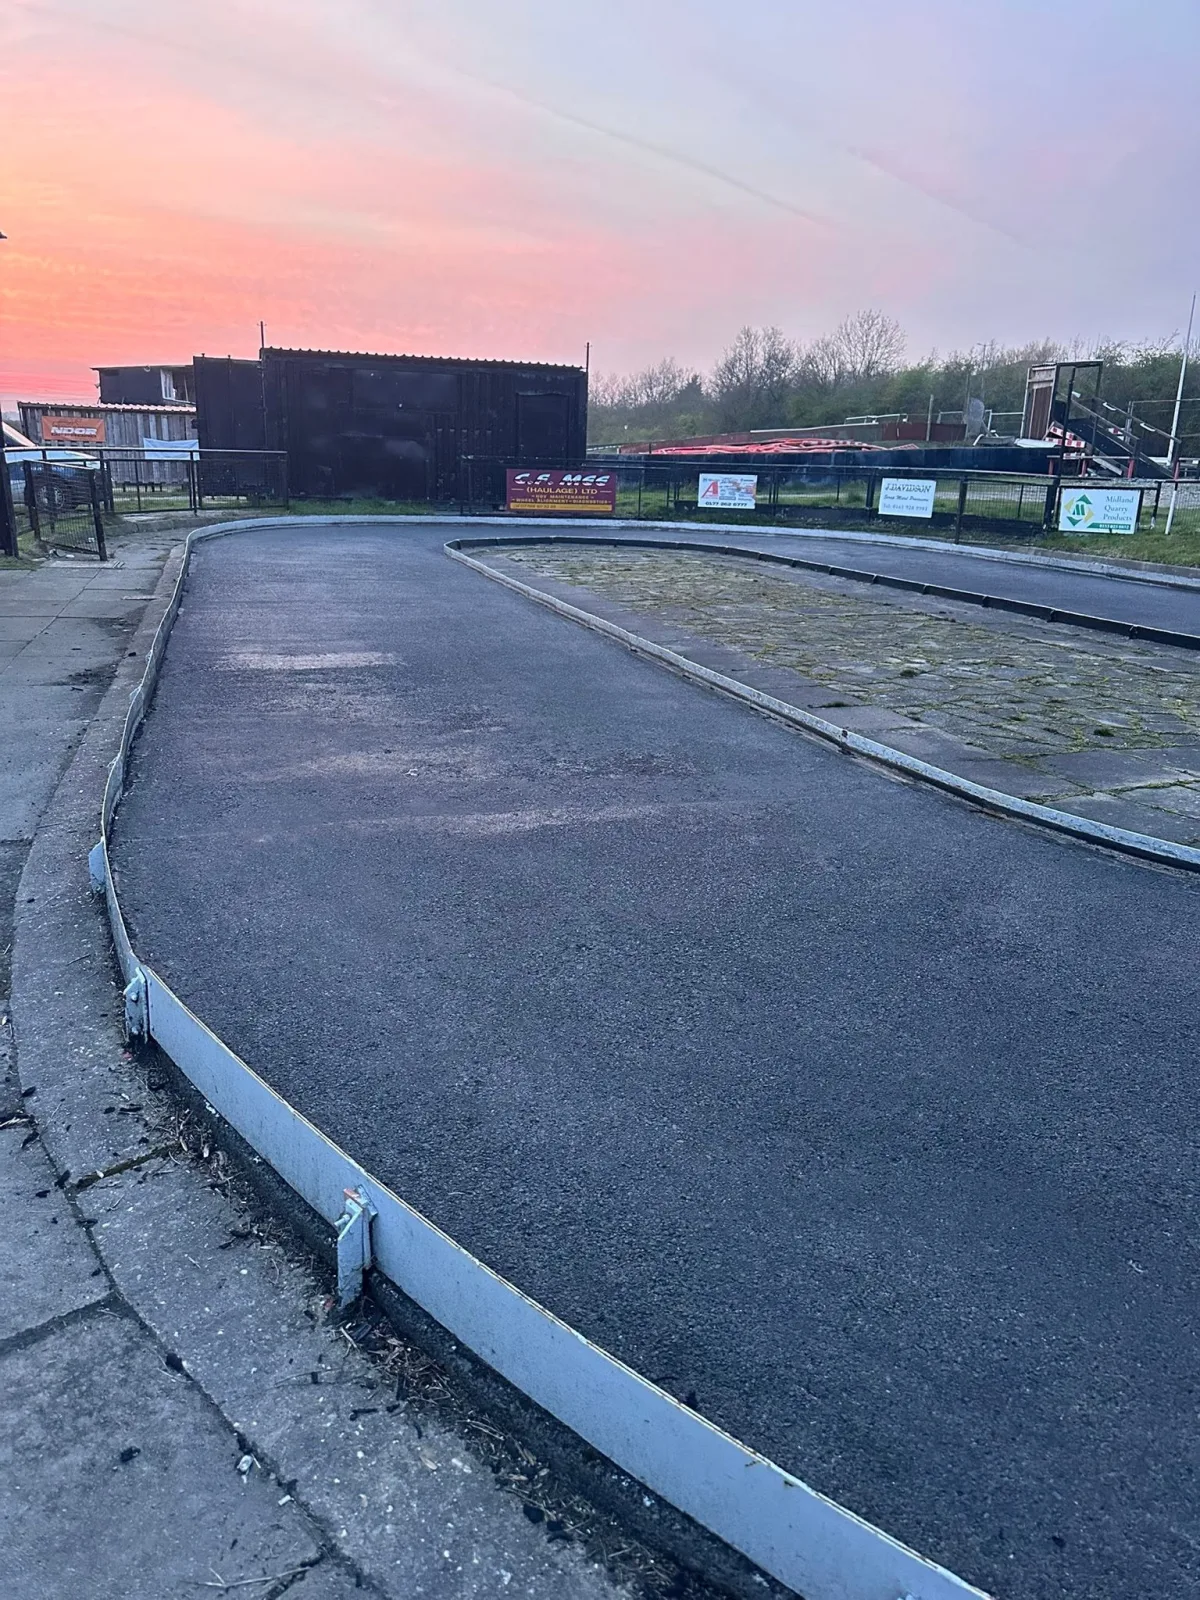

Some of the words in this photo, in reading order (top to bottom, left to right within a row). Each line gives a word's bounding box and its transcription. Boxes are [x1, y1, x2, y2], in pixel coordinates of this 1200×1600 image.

[526, 486, 578, 494] (HAULAGE)
[1106, 495, 1134, 503] Midland
[1105, 504, 1128, 514] Quarry
[1103, 513, 1133, 521] Products
